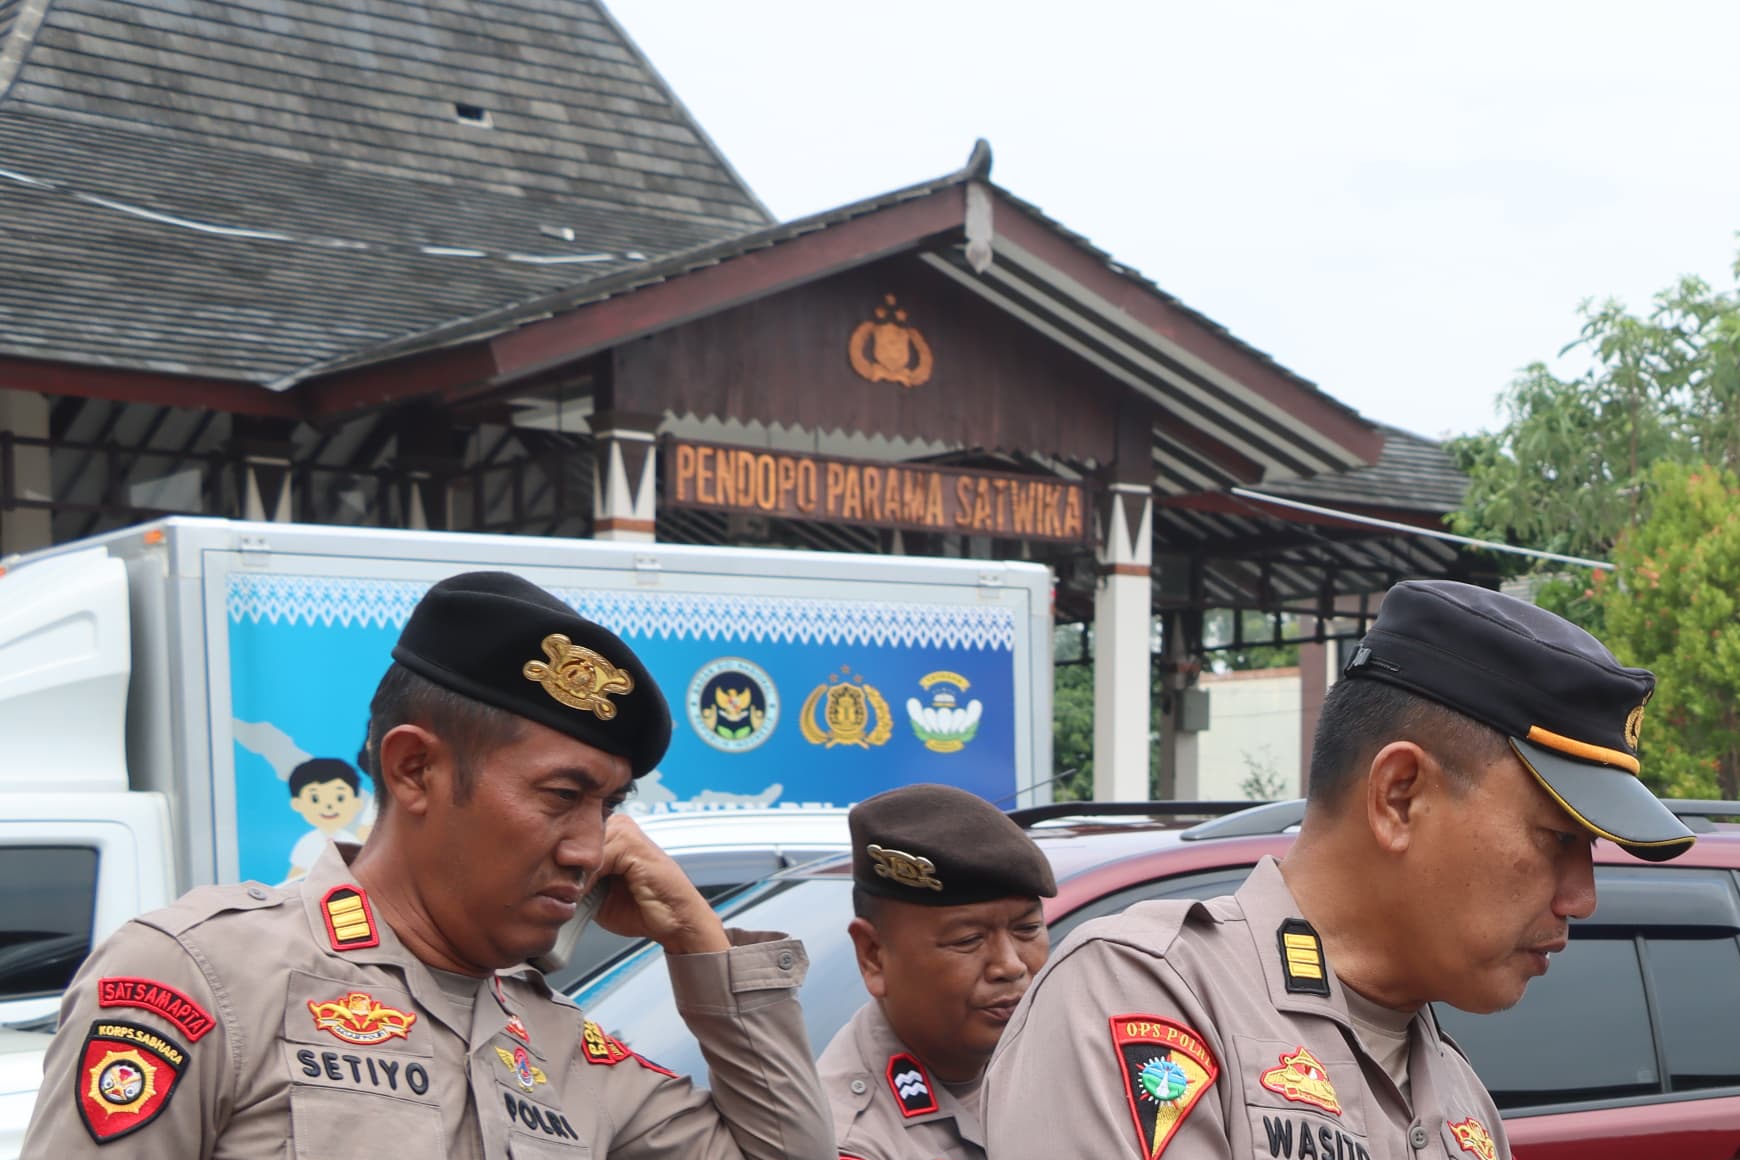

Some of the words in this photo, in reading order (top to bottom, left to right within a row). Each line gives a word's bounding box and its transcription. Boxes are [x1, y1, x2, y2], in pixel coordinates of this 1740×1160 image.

[676, 444, 818, 512] PENDOPO
[826, 461, 945, 528] PARAMA
[954, 475, 1083, 538] SATWIKA
[104, 983, 133, 1000] SAT
[134, 983, 206, 1033] SAMAPTA
[1126, 1023, 1161, 1038] OPS
[1166, 1027, 1212, 1067] POLRI
[297, 1049, 430, 1096] SETIYO
[504, 1092, 580, 1141] POLRI
